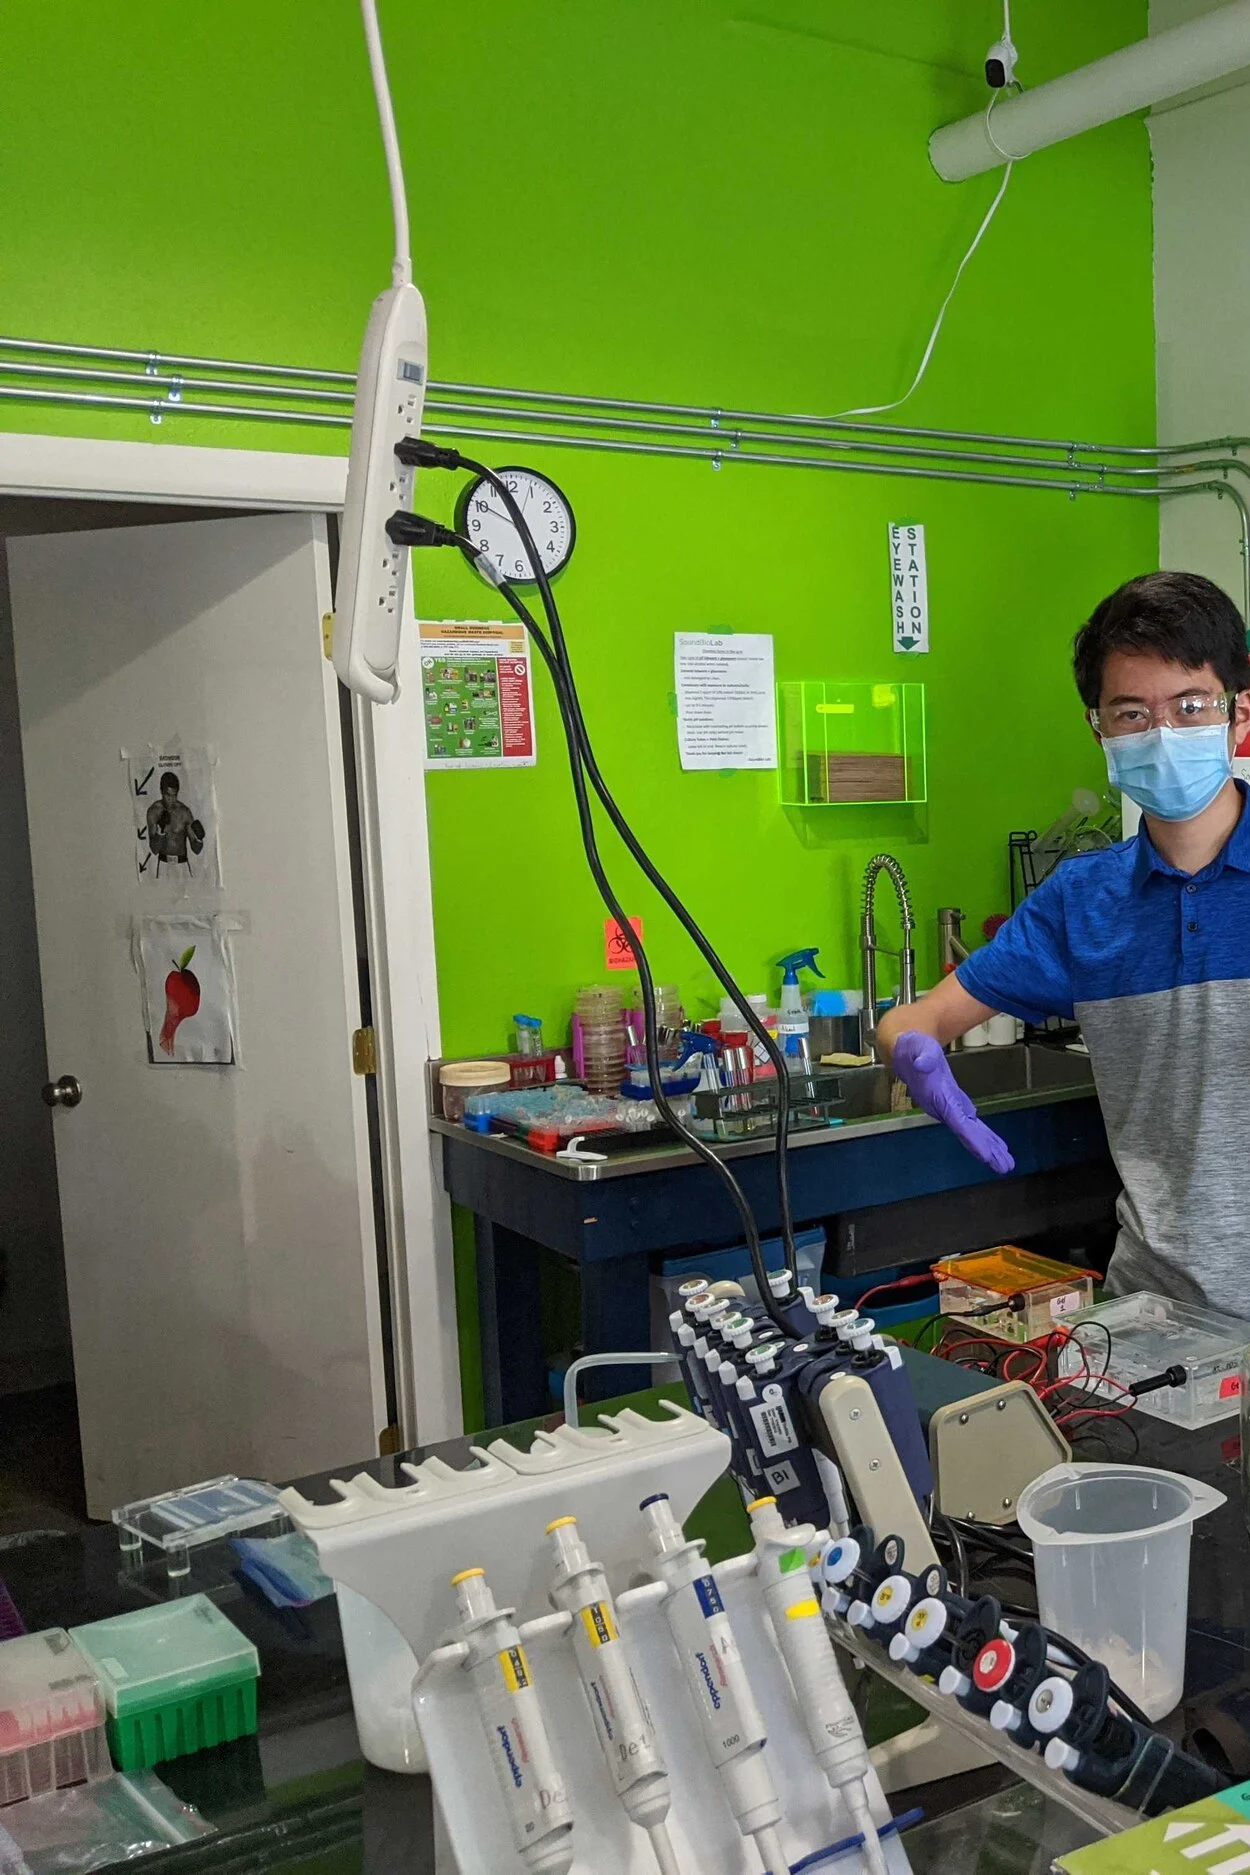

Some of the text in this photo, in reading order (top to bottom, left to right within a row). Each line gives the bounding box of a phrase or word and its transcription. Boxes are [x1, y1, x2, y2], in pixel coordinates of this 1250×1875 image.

[490, 486, 497, 497] 11
[506, 480, 518, 493] 12
[530, 486, 533, 498] 1
[476, 500, 488, 513] 10
[543, 501, 552, 513] 2
[472, 519, 481, 531] 9
[550, 521, 559, 533] 3
[480, 540, 489, 552] 8
[546, 541, 555, 552] 4
[495, 555, 504, 566] 7
[515, 560, 524, 572] 6
[892, 527, 904, 634] EYEWASH
[907, 528, 921, 634] STATION
[695, 1651, 721, 1710] eppendorf
[722, 1733, 741, 1749] 1000
[497, 1725, 522, 1788] eppendorf
